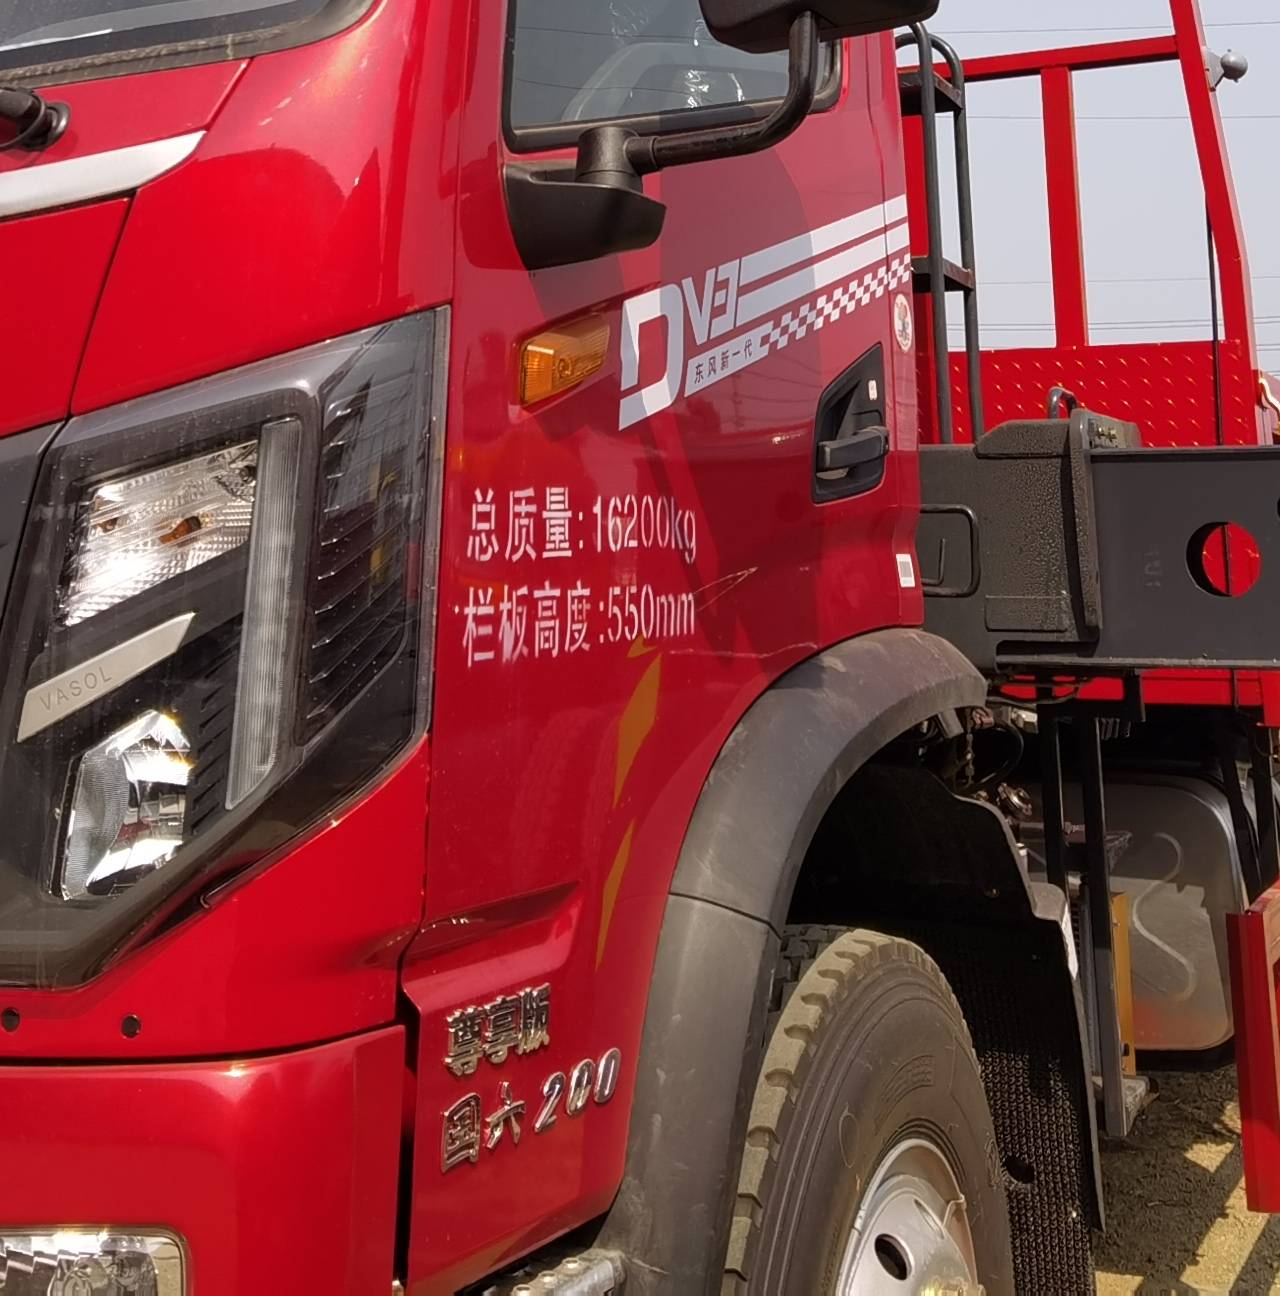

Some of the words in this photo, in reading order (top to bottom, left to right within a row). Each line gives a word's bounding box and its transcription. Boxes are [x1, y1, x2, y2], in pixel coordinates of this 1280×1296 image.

[694, 337, 754, 385] 东风新一代
[40, 666, 112, 711] VASOL
[534, 1046, 621, 1134] 200
